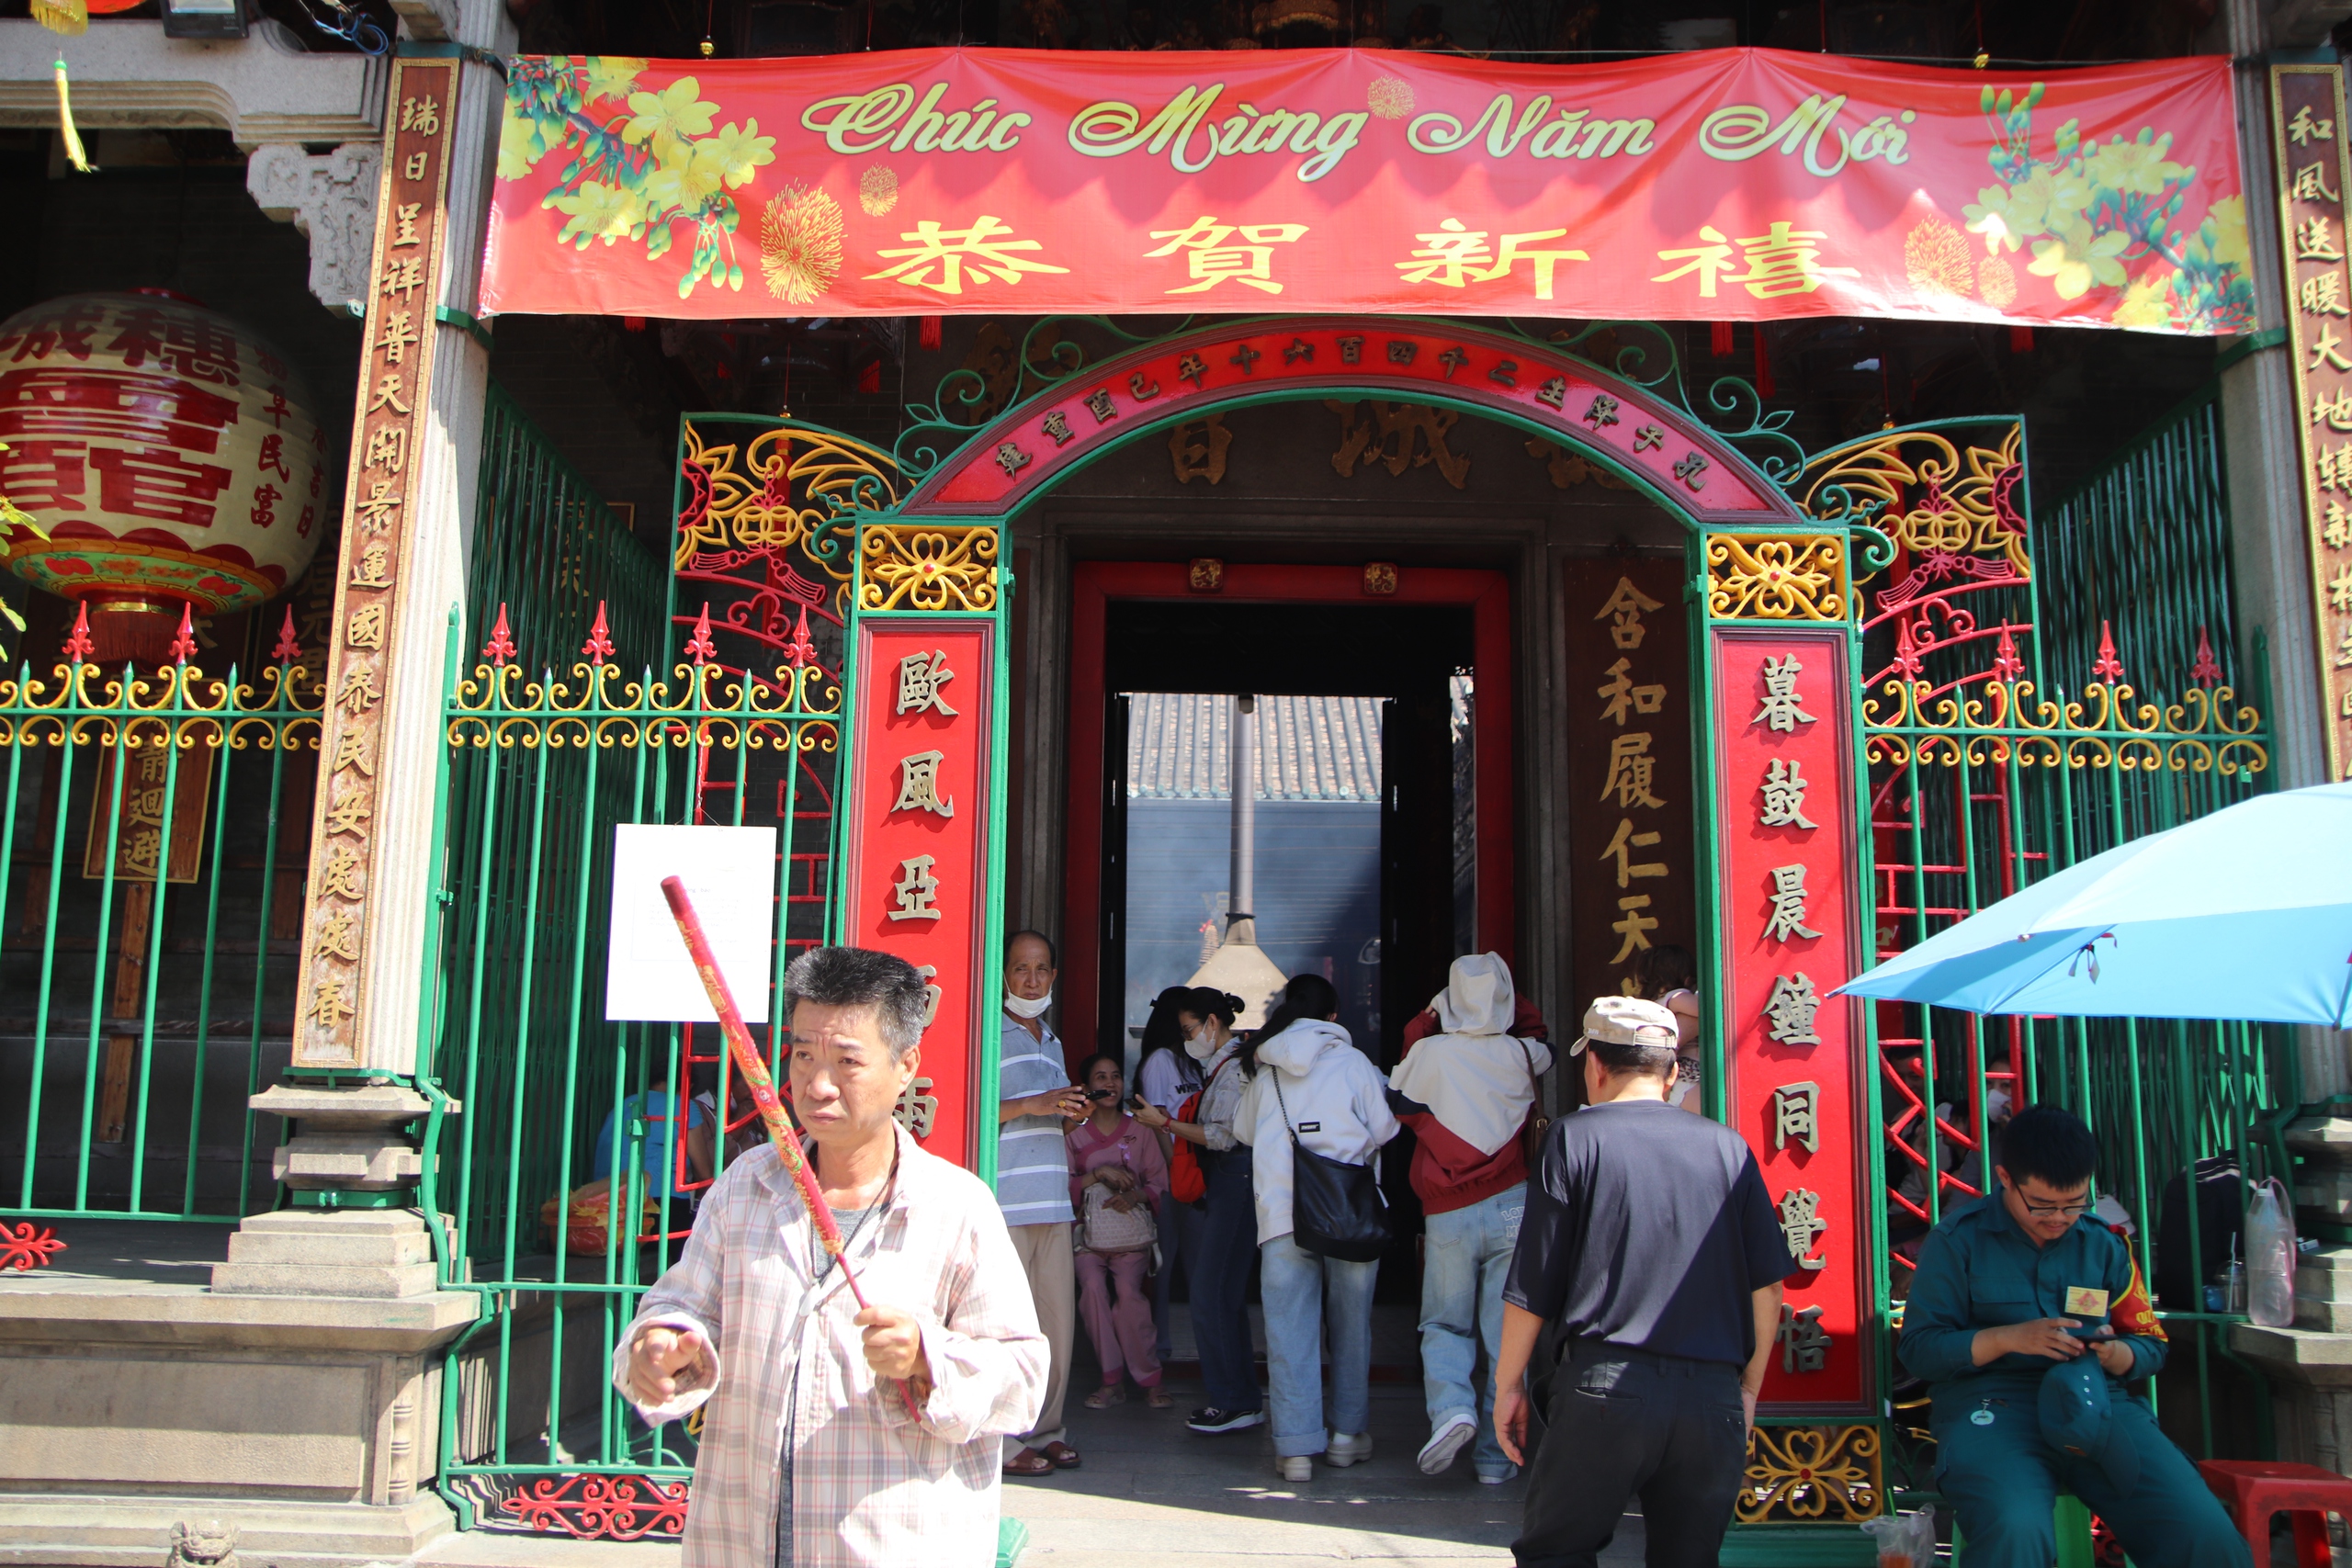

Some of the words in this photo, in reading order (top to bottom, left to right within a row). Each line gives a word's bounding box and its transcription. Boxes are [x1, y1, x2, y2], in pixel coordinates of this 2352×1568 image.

[801, 83, 1031, 154] Chúc
[1069, 83, 1369, 182] Mừng
[1408, 94, 1655, 159] Năm
[1699, 94, 1916, 176] Mới
[861, 215, 1861, 299] 恭賀新禧
[887, 649, 959, 1138] 歐風亞雨
[1594, 577, 1668, 997] 含和履仁天
